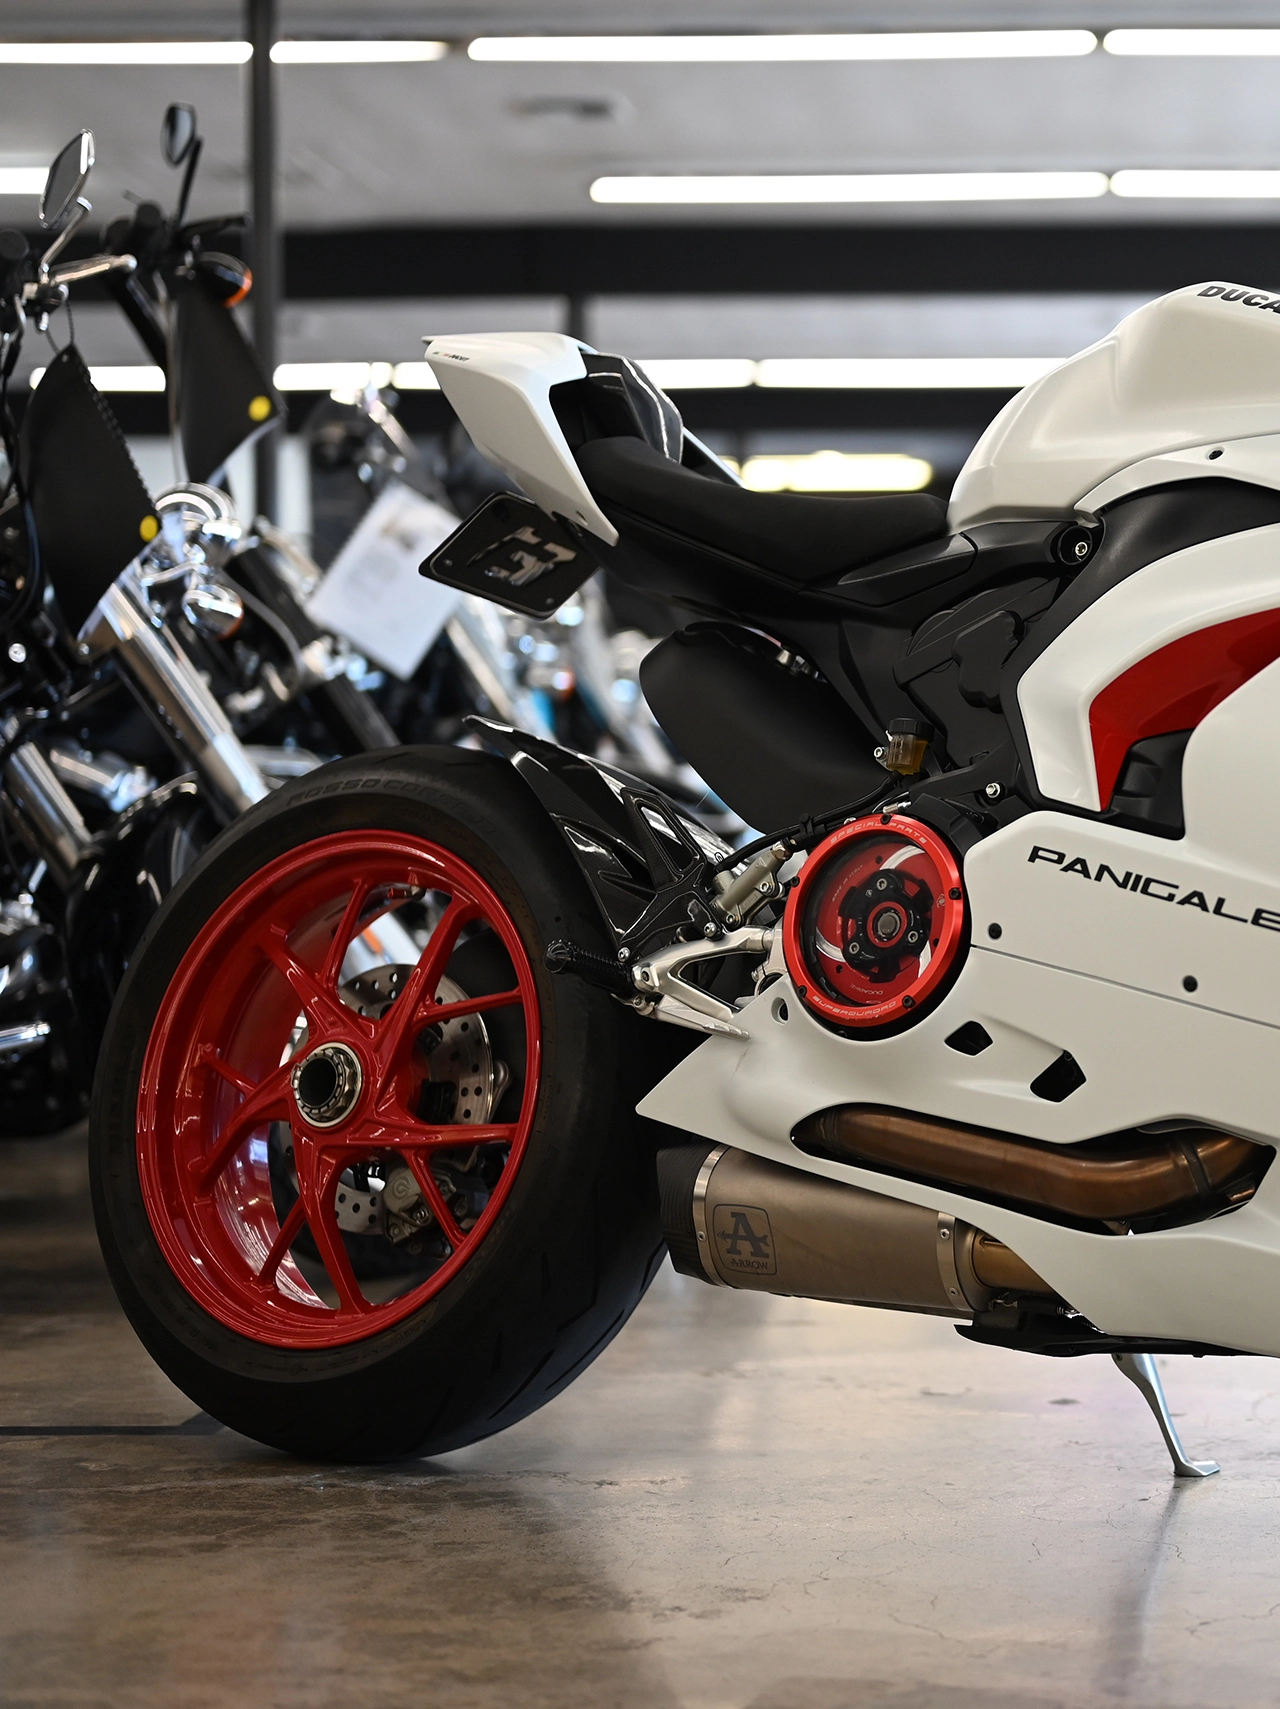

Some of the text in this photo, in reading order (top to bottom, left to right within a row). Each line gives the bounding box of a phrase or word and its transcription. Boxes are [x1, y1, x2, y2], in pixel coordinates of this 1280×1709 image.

[286, 778, 382, 807] ROSSO
[830, 821, 928, 845] SPECIAL PARTS
[812, 995, 896, 1017] SUPERQUADRO
[730, 1258, 769, 1270] ARROW
